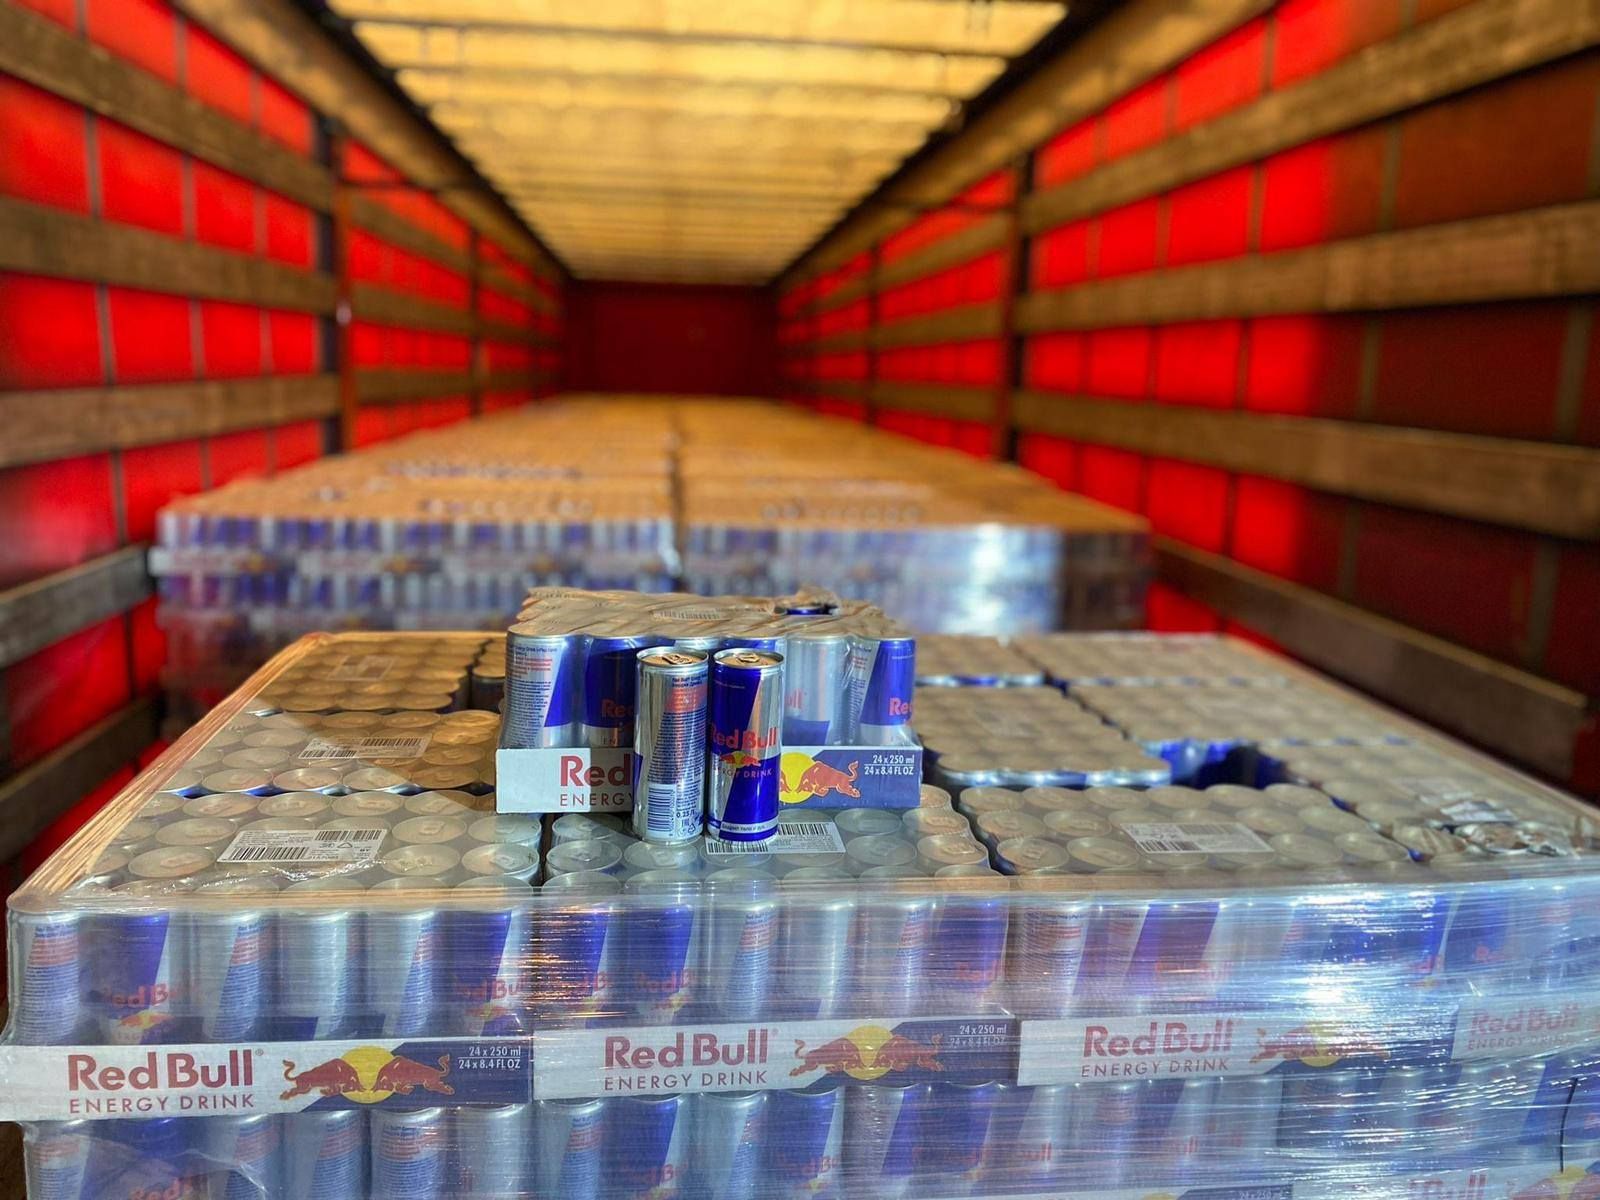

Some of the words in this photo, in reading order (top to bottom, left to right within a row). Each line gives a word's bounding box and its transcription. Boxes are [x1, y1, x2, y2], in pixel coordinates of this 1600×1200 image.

[601, 698, 632, 719] Re
[889, 697, 912, 716] Re
[742, 727, 777, 750] Bull
[872, 754, 883, 764] 24
[890, 754, 904, 764] 250
[905, 754, 915, 764] ml
[560, 753, 631, 787] Red
[743, 767, 773, 778] DRINK
[864, 766, 875, 775] 24
[881, 766, 893, 775] 8.4
[959, 1024, 970, 1035] 24
[978, 1024, 995, 1034] 250
[996, 1024, 1007, 1034] ml
[1084, 1021, 1158, 1057] Red
[468, 1046, 480, 1057] 24
[482, 1049, 488, 1057] x
[489, 1046, 508, 1057] 250
[510, 1045, 520, 1056] ml
[604, 1031, 685, 1070] Red
[67, 1051, 159, 1092] Red
[459, 1059, 471, 1070] 24
[479, 1059, 494, 1069] 8.4
[1081, 1059, 1162, 1078] ENERGY
[1169, 1056, 1229, 1073] DRINK
[604, 1073, 692, 1091] ENERGY
[702, 1070, 768, 1087] DRINK
[69, 1096, 168, 1114] ENERGY
[180, 1093, 255, 1110] DRINK
